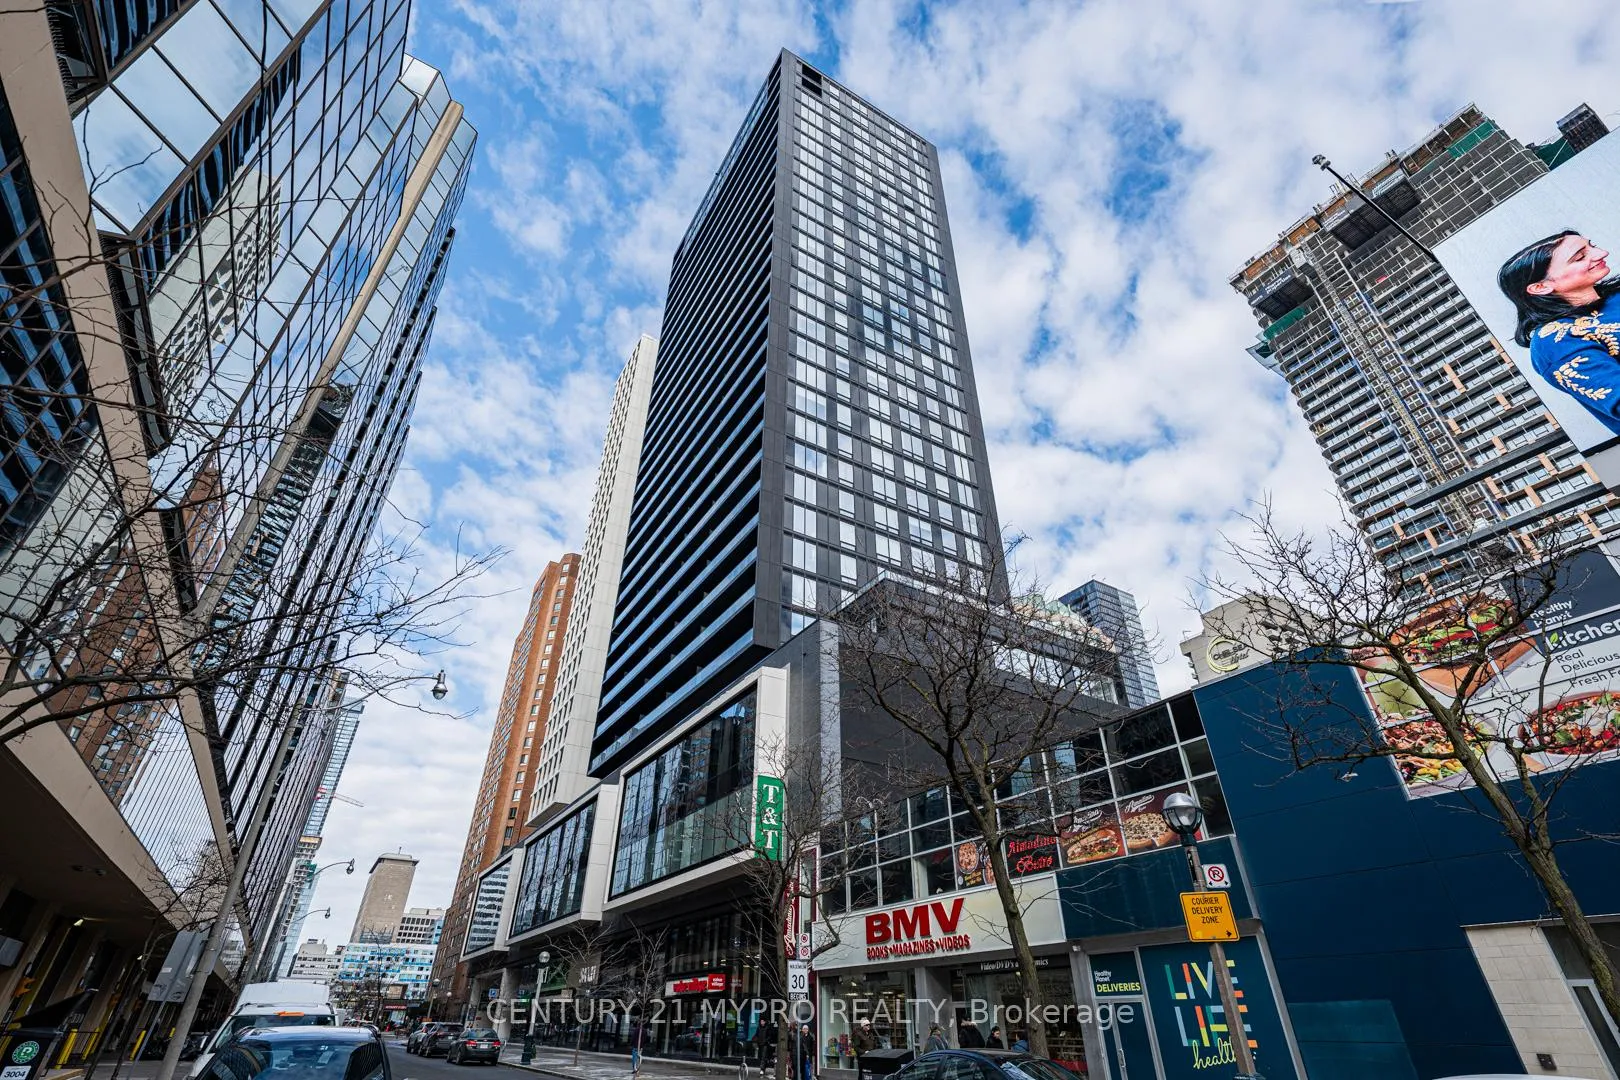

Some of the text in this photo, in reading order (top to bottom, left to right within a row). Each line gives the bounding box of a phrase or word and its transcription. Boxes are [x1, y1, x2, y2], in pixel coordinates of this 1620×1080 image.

[1533, 610, 1573, 628] Panet
[1555, 649, 1585, 664] Real
[1561, 653, 1620, 674] Delicious
[1569, 671, 1608, 689] Fresh
[762, 784, 779, 849] T&T
[1191, 906, 1223, 915] DELIVERY
[1192, 897, 1219, 906] COURIER
[865, 897, 965, 944] BMV
[1201, 916, 1219, 924] ZONE
[866, 933, 971, 960] BOOKS MAGAZINES VIDEOS
[791, 974, 805, 989] 30
[1096, 982, 1141, 993] DELIVERIES
[1164, 959, 1244, 1000] LIVE
[789, 992, 807, 1000] BEGINS
[1174, 1005, 1258, 1048] LIFE
[1193, 1035, 1237, 1070] healt
[4, 1070, 26, 1078] 3004
